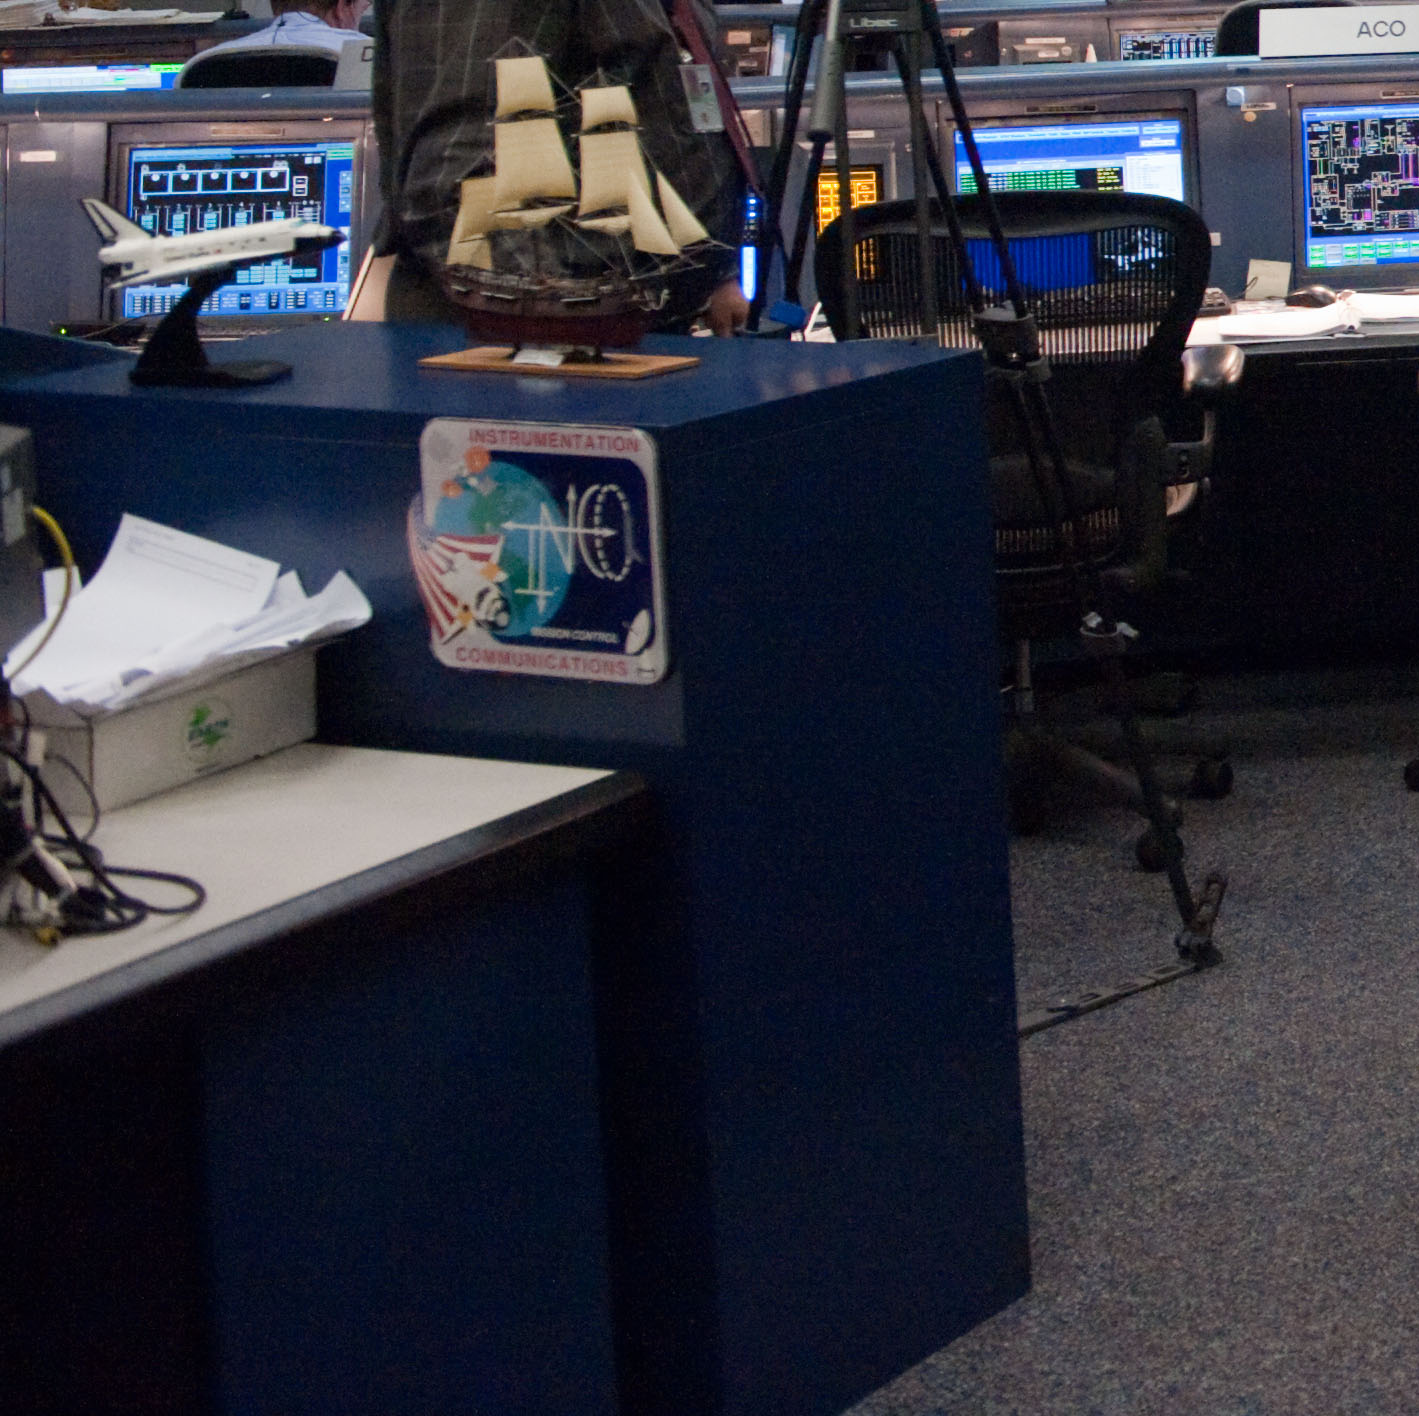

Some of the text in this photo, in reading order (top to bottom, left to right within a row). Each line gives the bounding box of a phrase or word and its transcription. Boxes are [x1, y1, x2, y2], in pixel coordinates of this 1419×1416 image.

[1356, 19, 1407, 39] ACO
[468, 427, 641, 453] INSTRUMENTATION
[455, 645, 630, 677] COMMUNICATIONS
